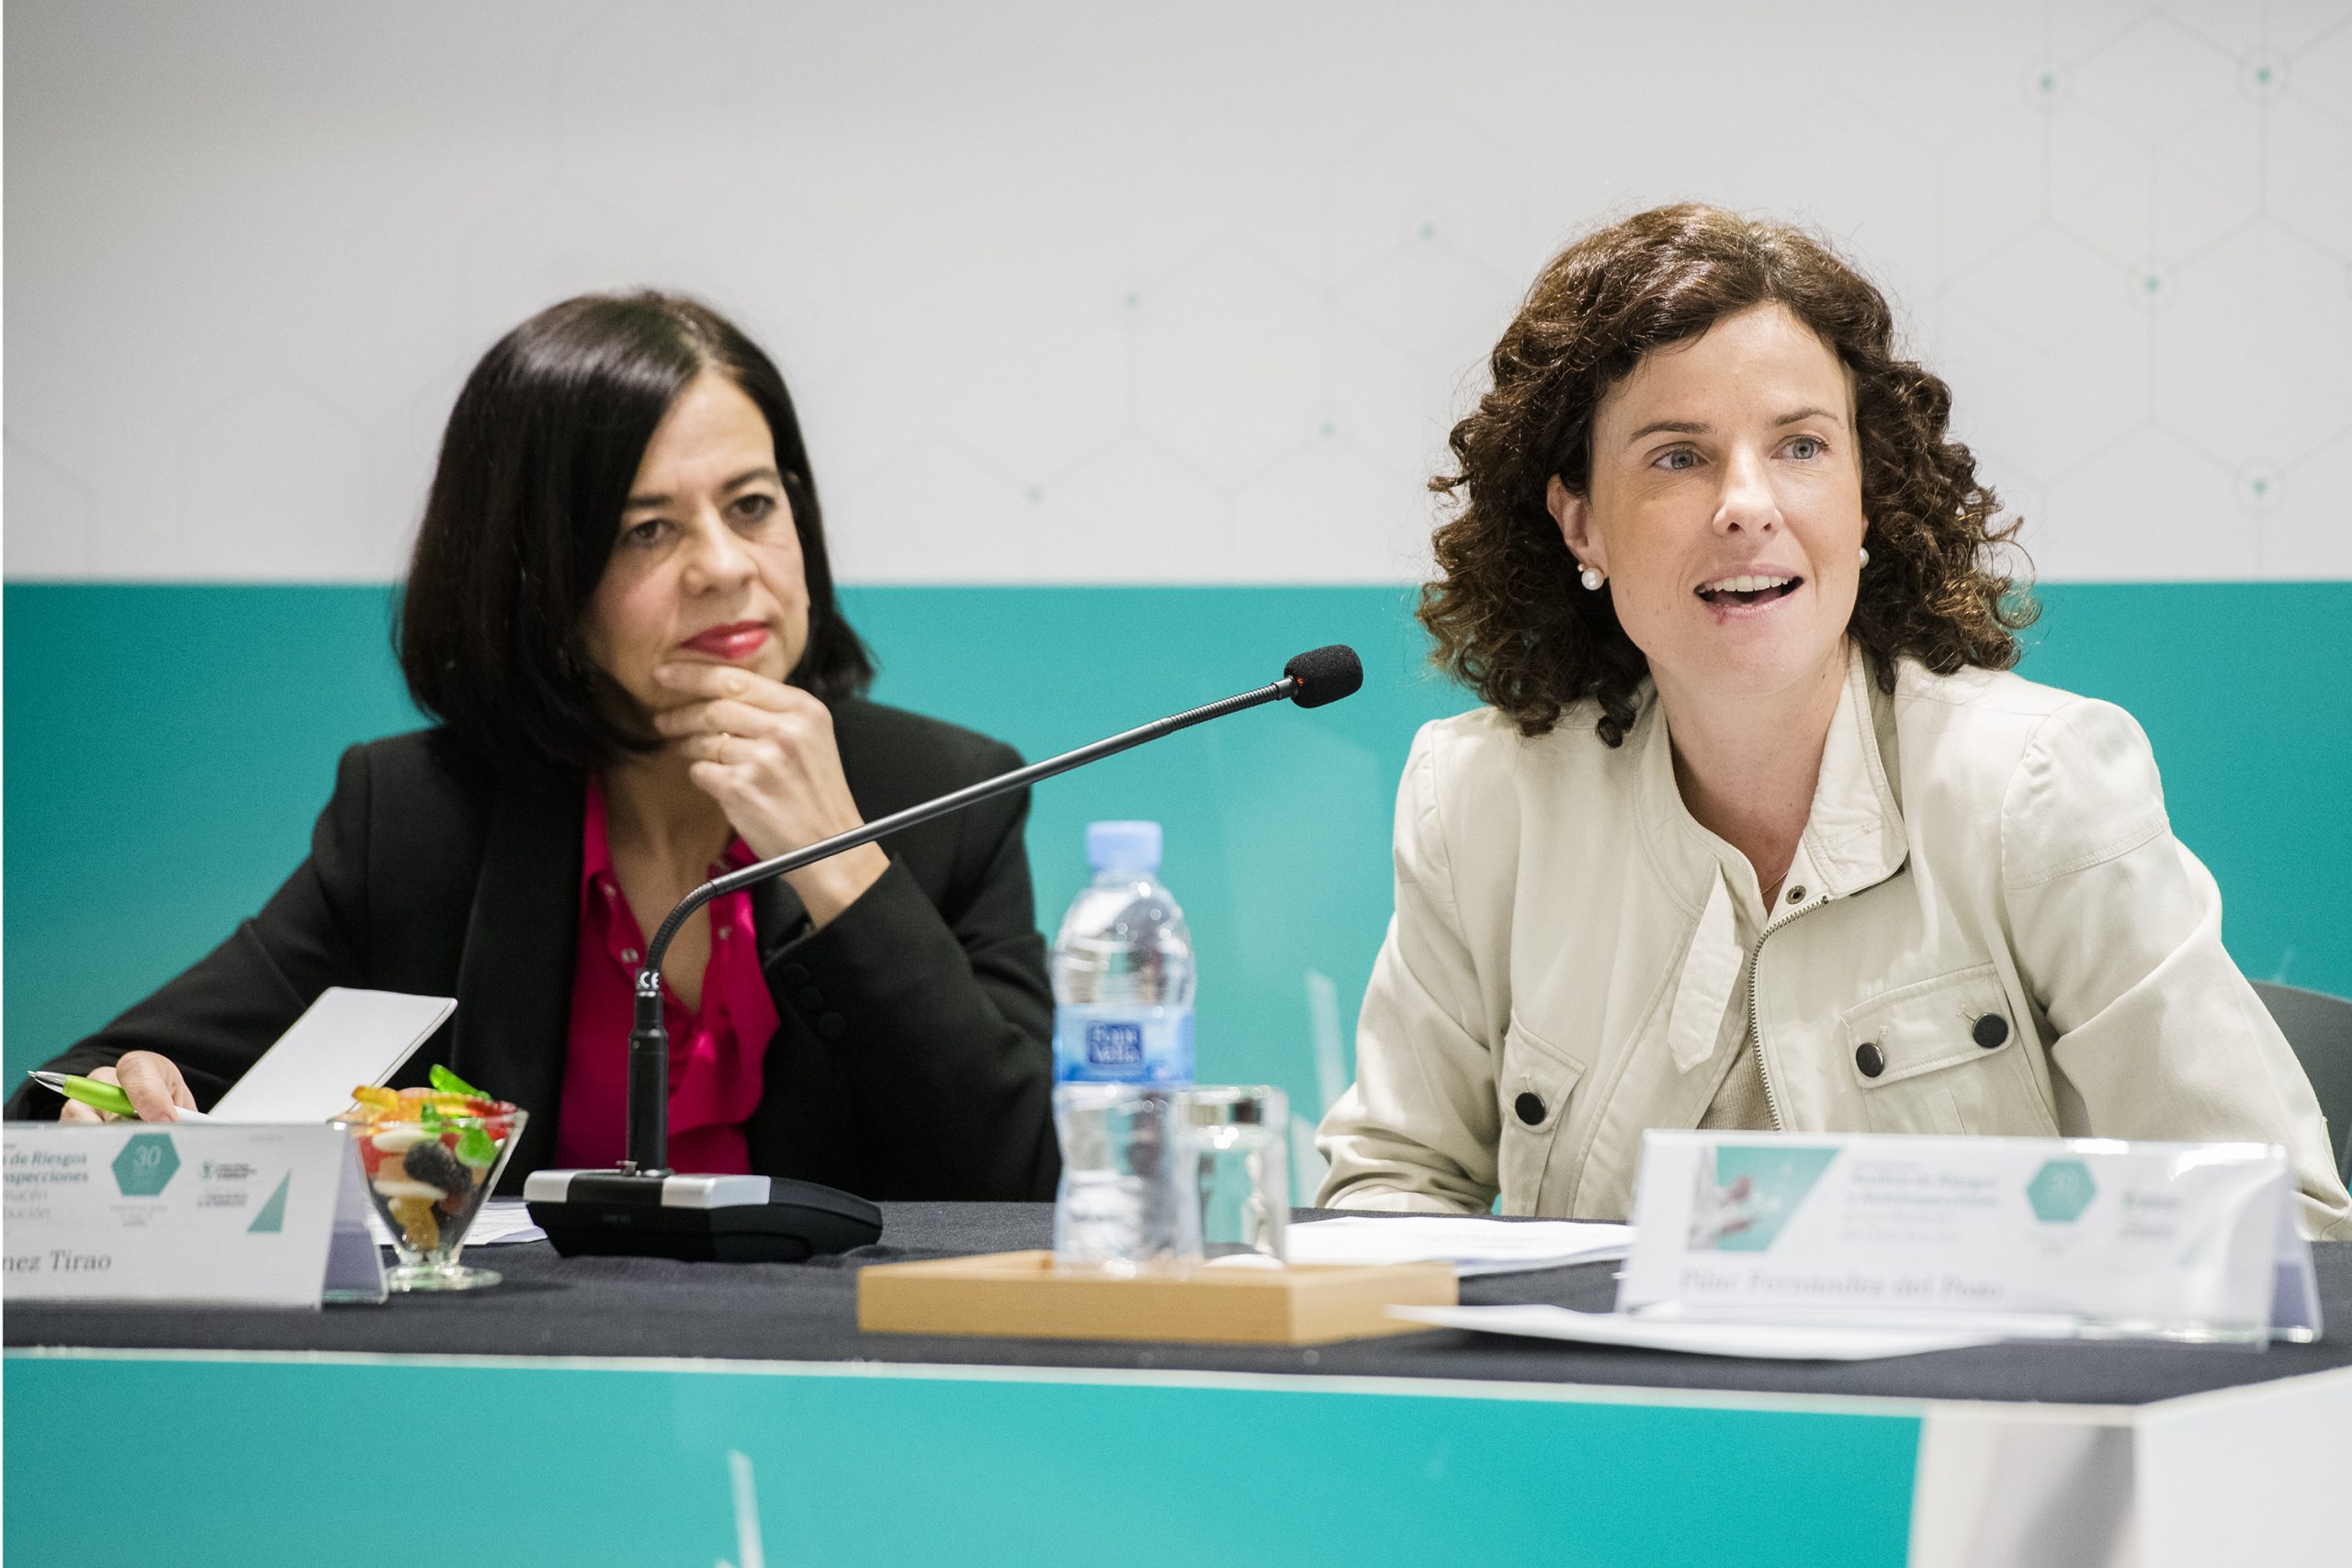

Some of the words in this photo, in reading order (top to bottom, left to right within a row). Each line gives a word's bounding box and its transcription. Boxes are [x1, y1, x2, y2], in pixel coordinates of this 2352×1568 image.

[639, 971, 660, 989] CE
[10, 1151, 28, 1165] de
[31, 1151, 87, 1168] Riesgos
[133, 1145, 162, 1168] 30
[50, 1248, 111, 1271] Tirao
